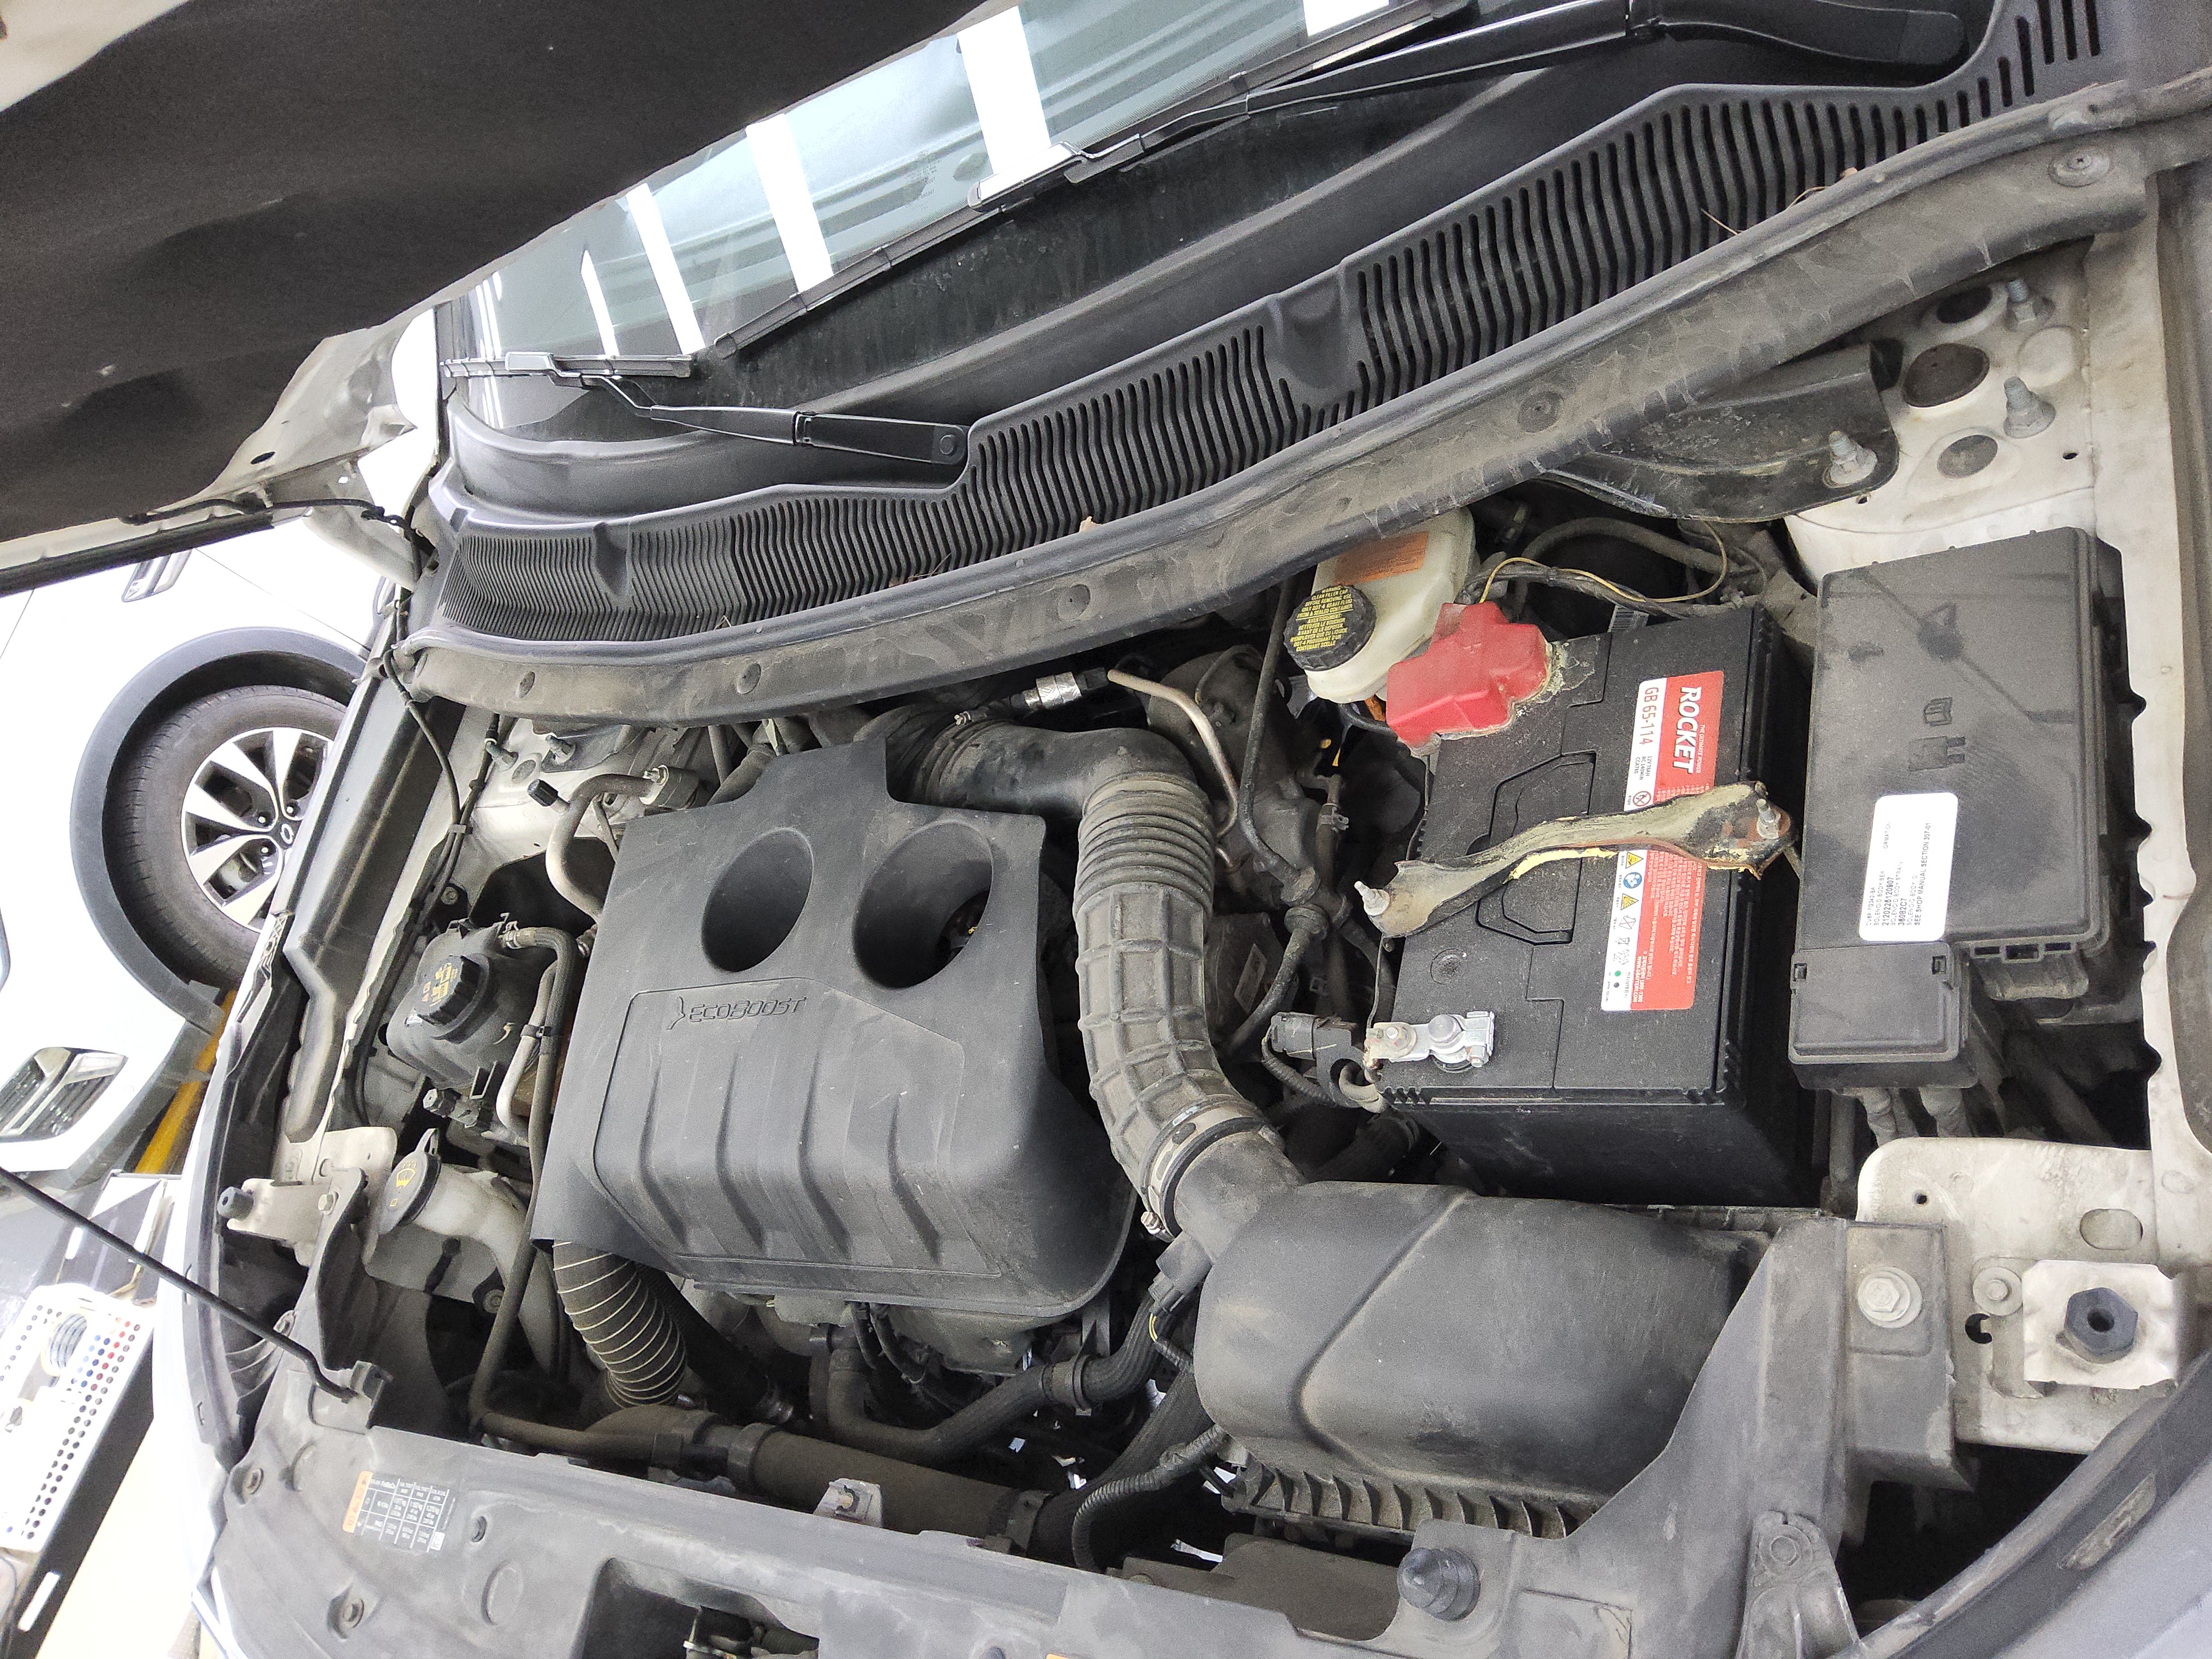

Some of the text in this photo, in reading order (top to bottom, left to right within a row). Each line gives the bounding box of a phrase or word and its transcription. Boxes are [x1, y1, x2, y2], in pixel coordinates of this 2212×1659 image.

[1639, 687, 1659, 745] GB 65-114
[1672, 686, 1702, 774] ROCKET
[1920, 842, 1929, 867] SECTION
[1917, 869, 1926, 894] MANUAL
[1874, 899, 1882, 926] SOLENOID
